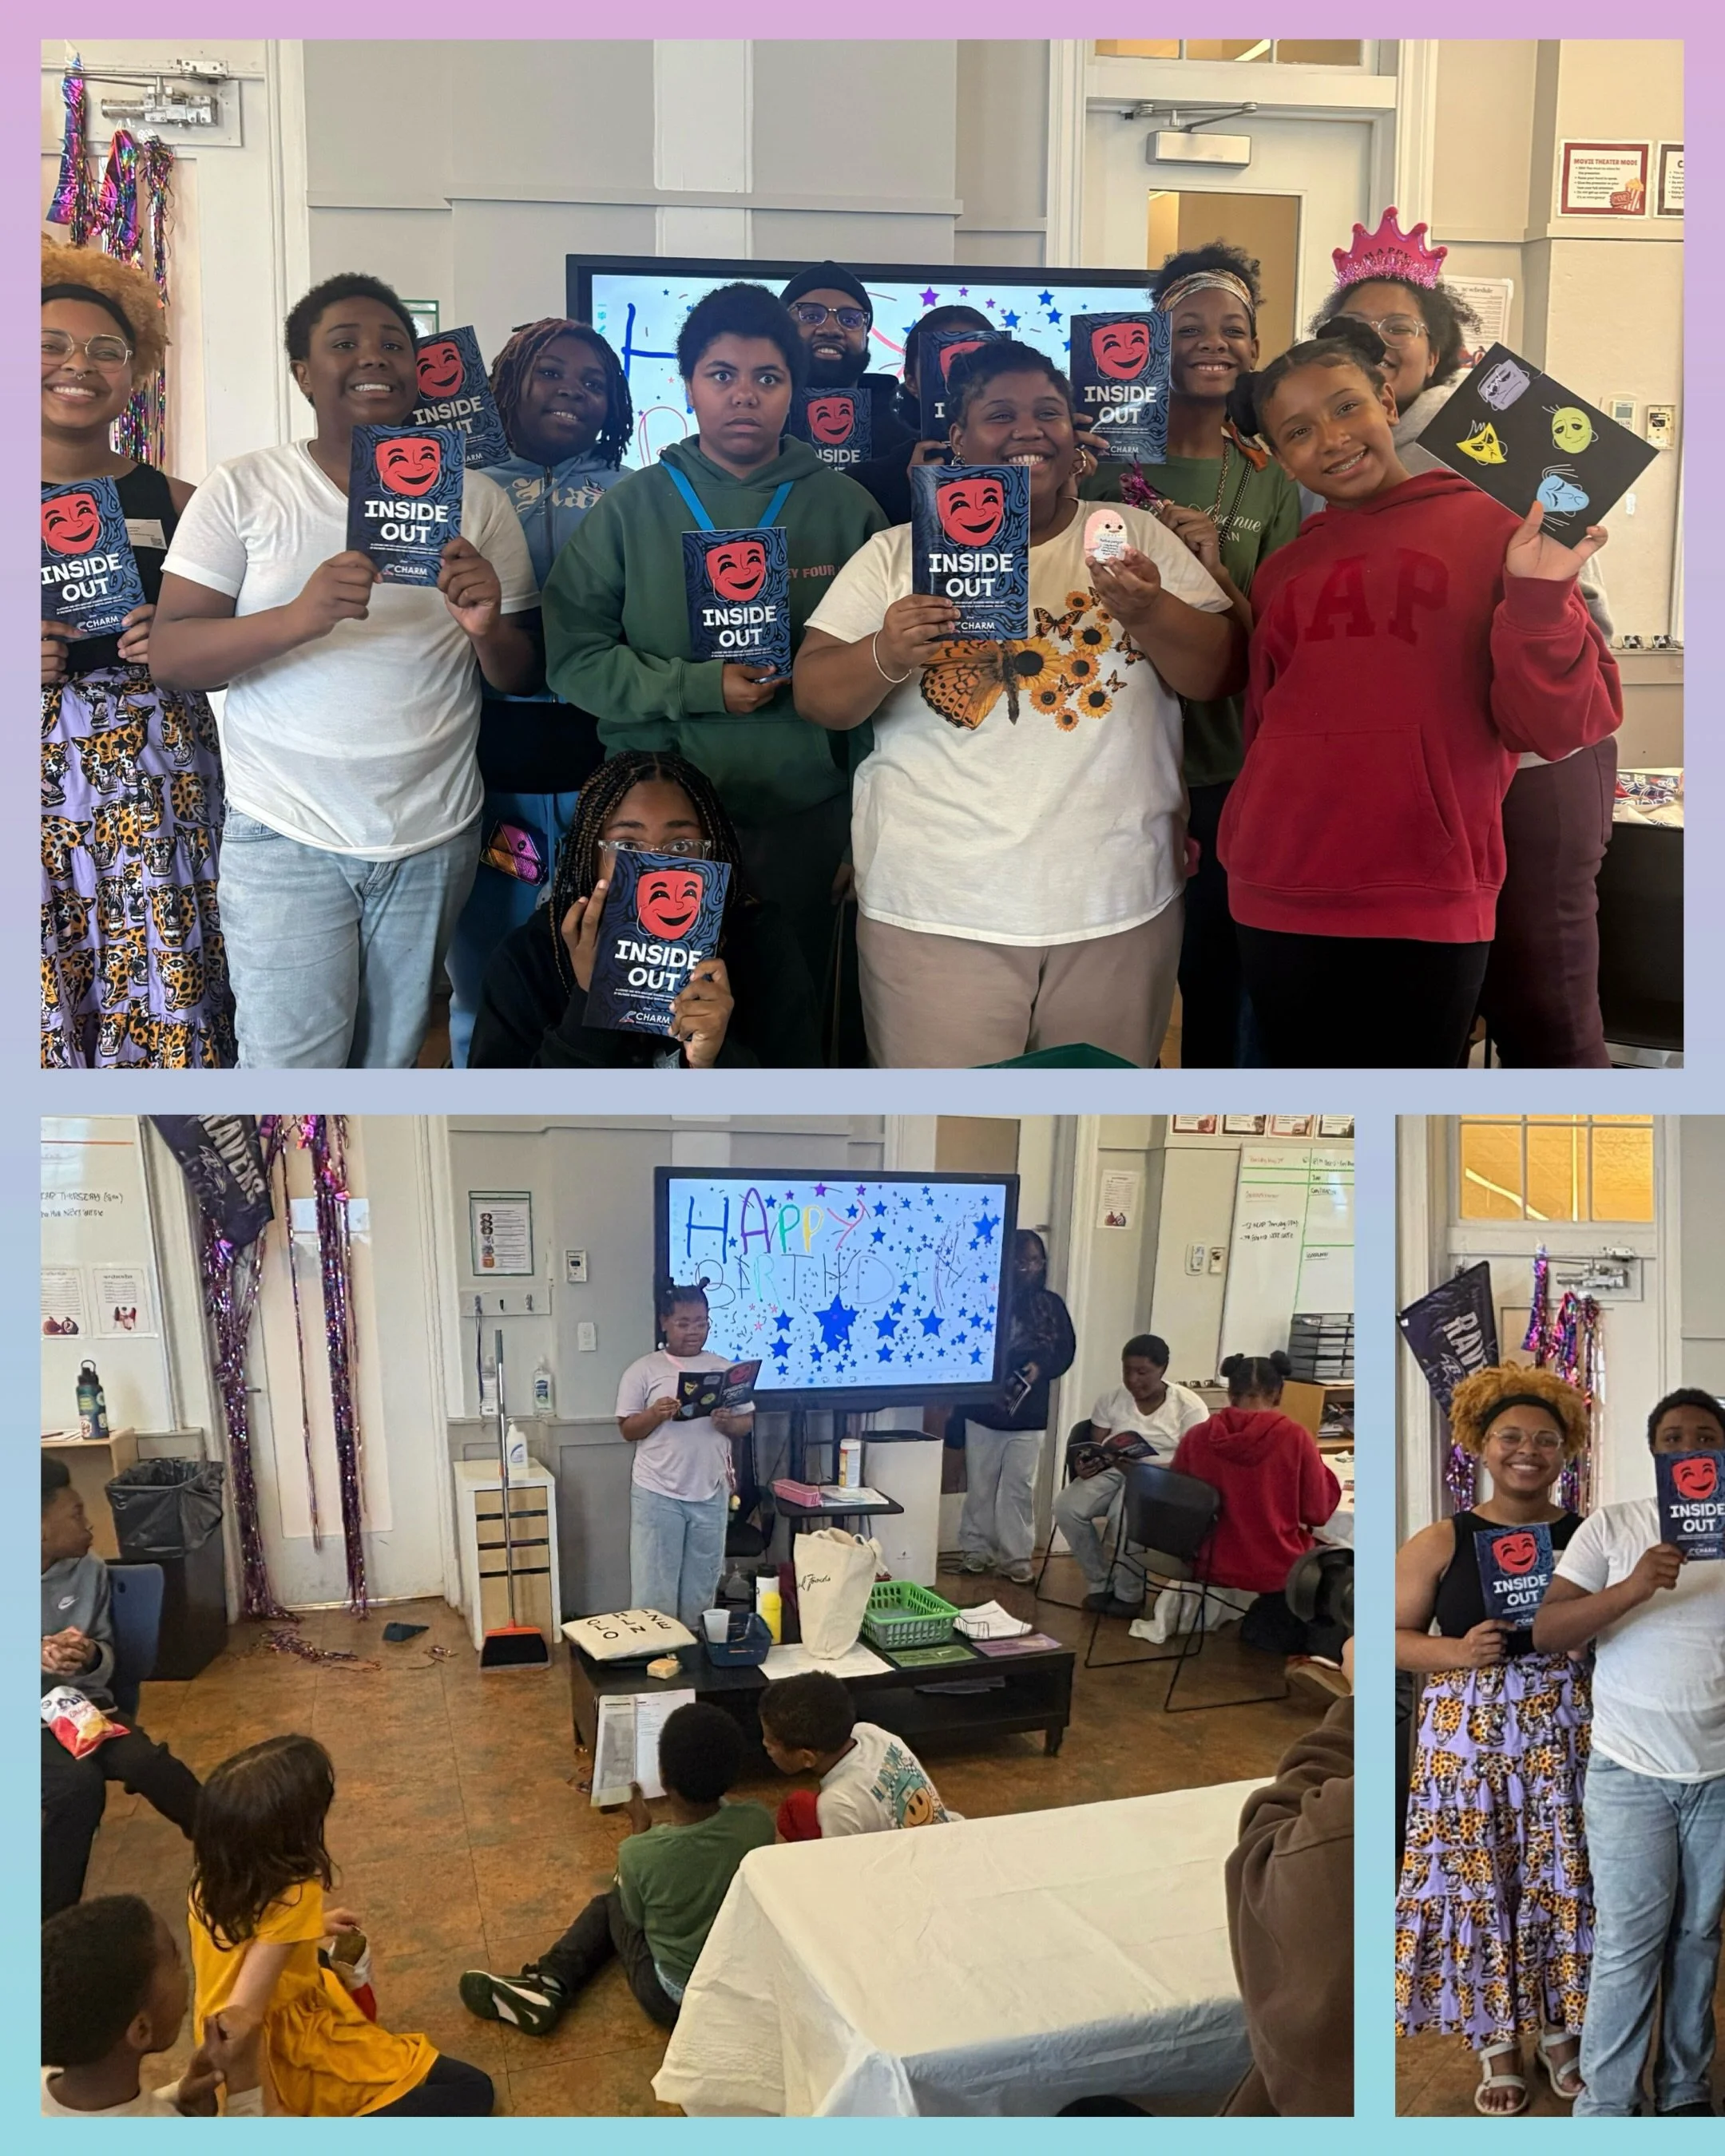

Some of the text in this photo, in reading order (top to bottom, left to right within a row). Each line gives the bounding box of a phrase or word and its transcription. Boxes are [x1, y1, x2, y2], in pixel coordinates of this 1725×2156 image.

[1364, 247, 1411, 260] HAPPY
[1084, 386, 1157, 403] INSIDE
[412, 396, 485, 426] INSIDE
[1098, 406, 1141, 425] OUT
[466, 453, 483, 462] ARM
[816, 449, 861, 463] NSIDE
[364, 500, 449, 522] INSIDE
[380, 522, 431, 544] OUT
[41, 553, 123, 585] INSIDE
[394, 565, 428, 576] CHARM
[802, 565, 835, 578] FOUR
[928, 553, 1013, 573] INSIDE
[61, 577, 109, 601] OUT
[946, 578, 996, 597] OUT
[85, 616, 119, 628] CHARM
[703, 605, 777, 626] INSIDE
[961, 621, 995, 630] CHARM
[719, 628, 763, 648] OUT
[614, 940, 703, 969] INSIDE
[628, 967, 681, 992] OUT
[636, 1012, 671, 1024] CHARM
[686, 1187, 867, 1263] HAPPY
[1669, 1503, 1725, 1518] INSIDE
[1683, 1519, 1716, 1532] OUT
[1493, 1574, 1549, 1594] INSIDE
[1507, 1590, 1539, 1607] OUT
